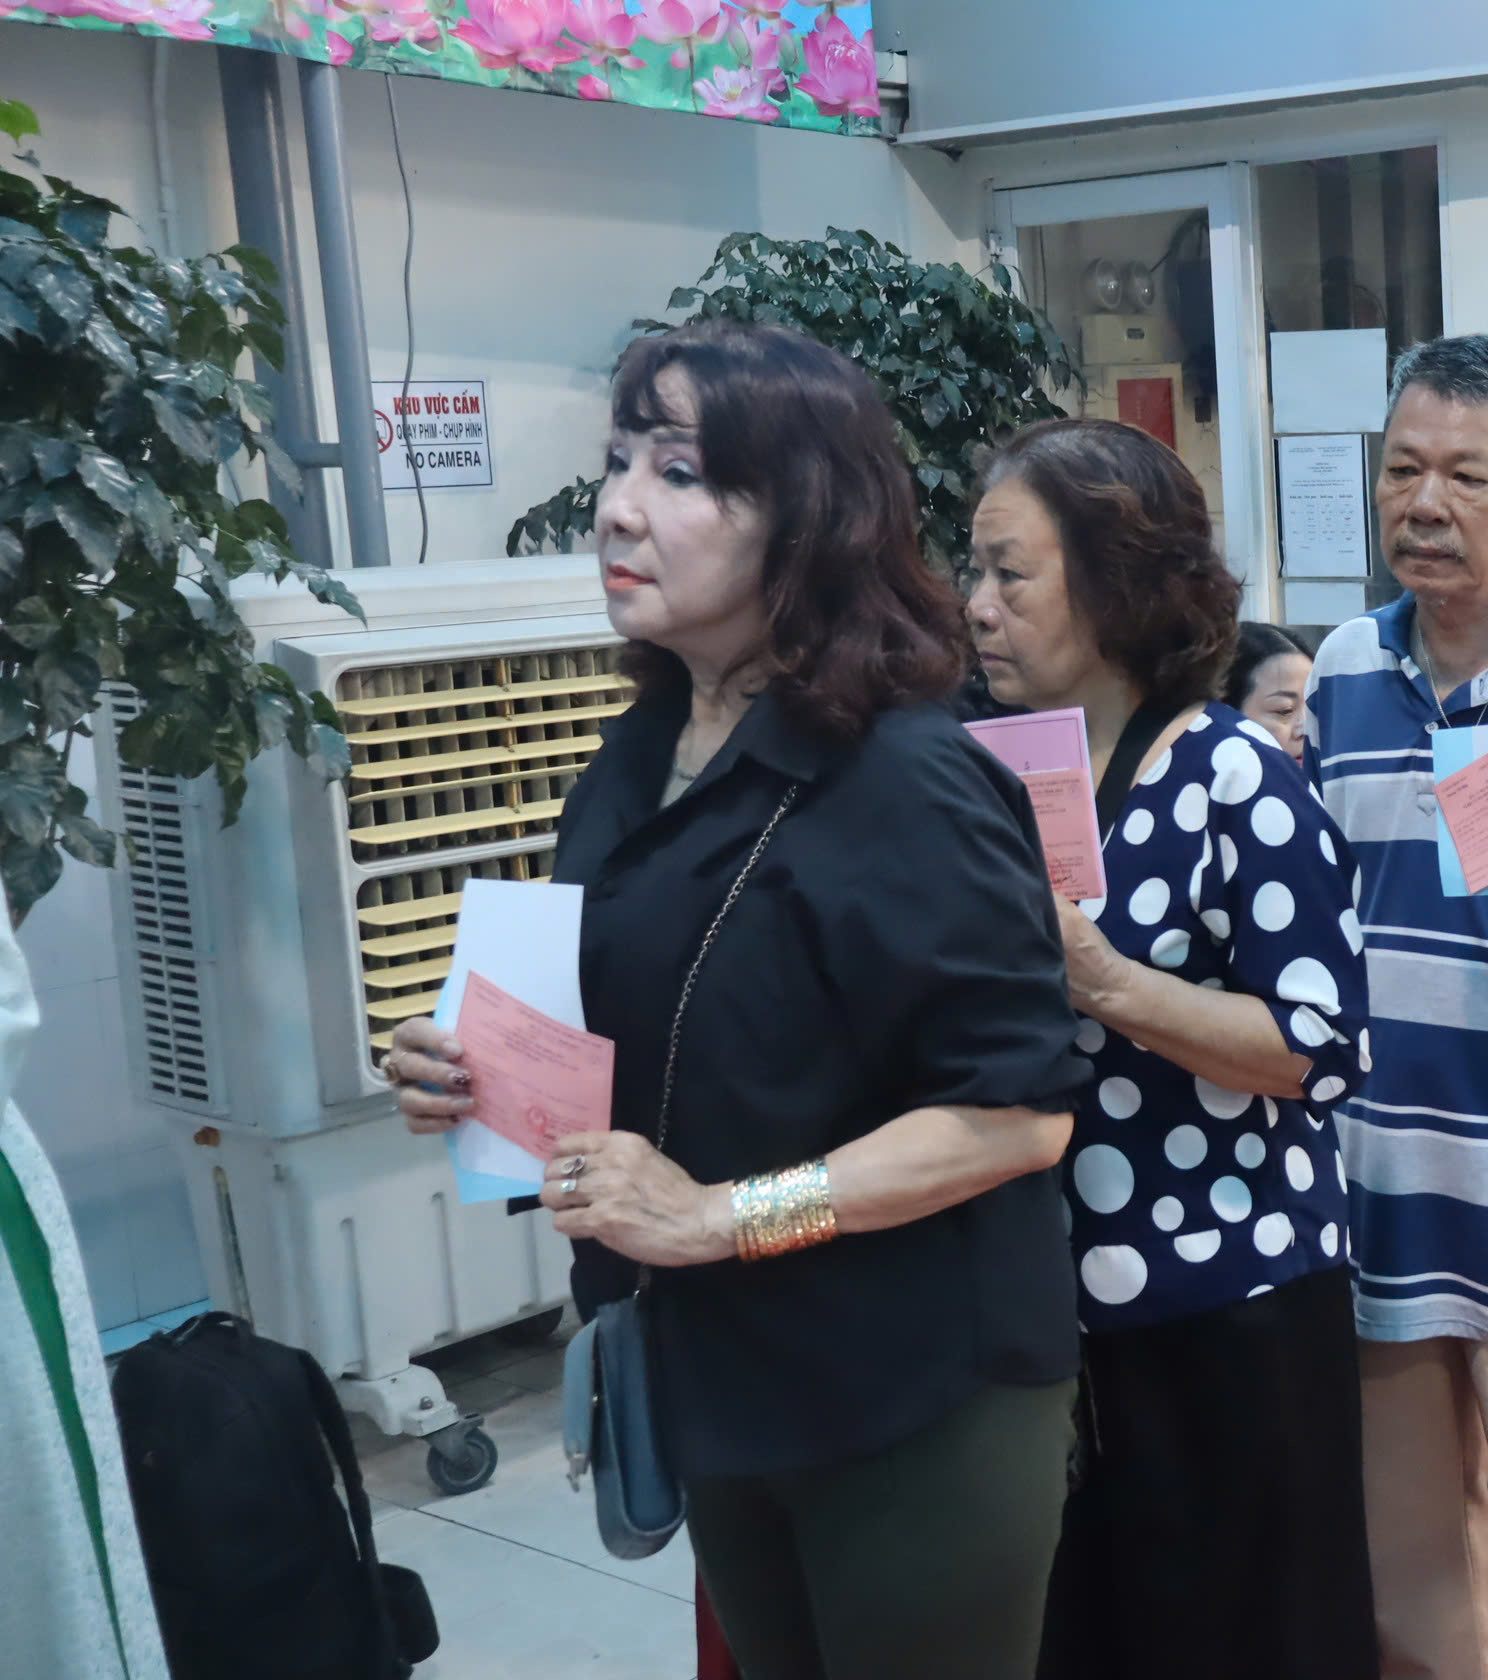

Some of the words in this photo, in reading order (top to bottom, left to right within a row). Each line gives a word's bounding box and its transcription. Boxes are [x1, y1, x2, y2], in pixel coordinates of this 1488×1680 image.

[393, 396, 421, 416] KHU
[424, 392, 449, 419] VỰC
[453, 389, 480, 415] CẤM
[420, 423, 438, 439] PHIM
[443, 422, 464, 441] CHỤP
[465, 419, 483, 438] HÌNH
[427, 451, 482, 469] CAMERA
